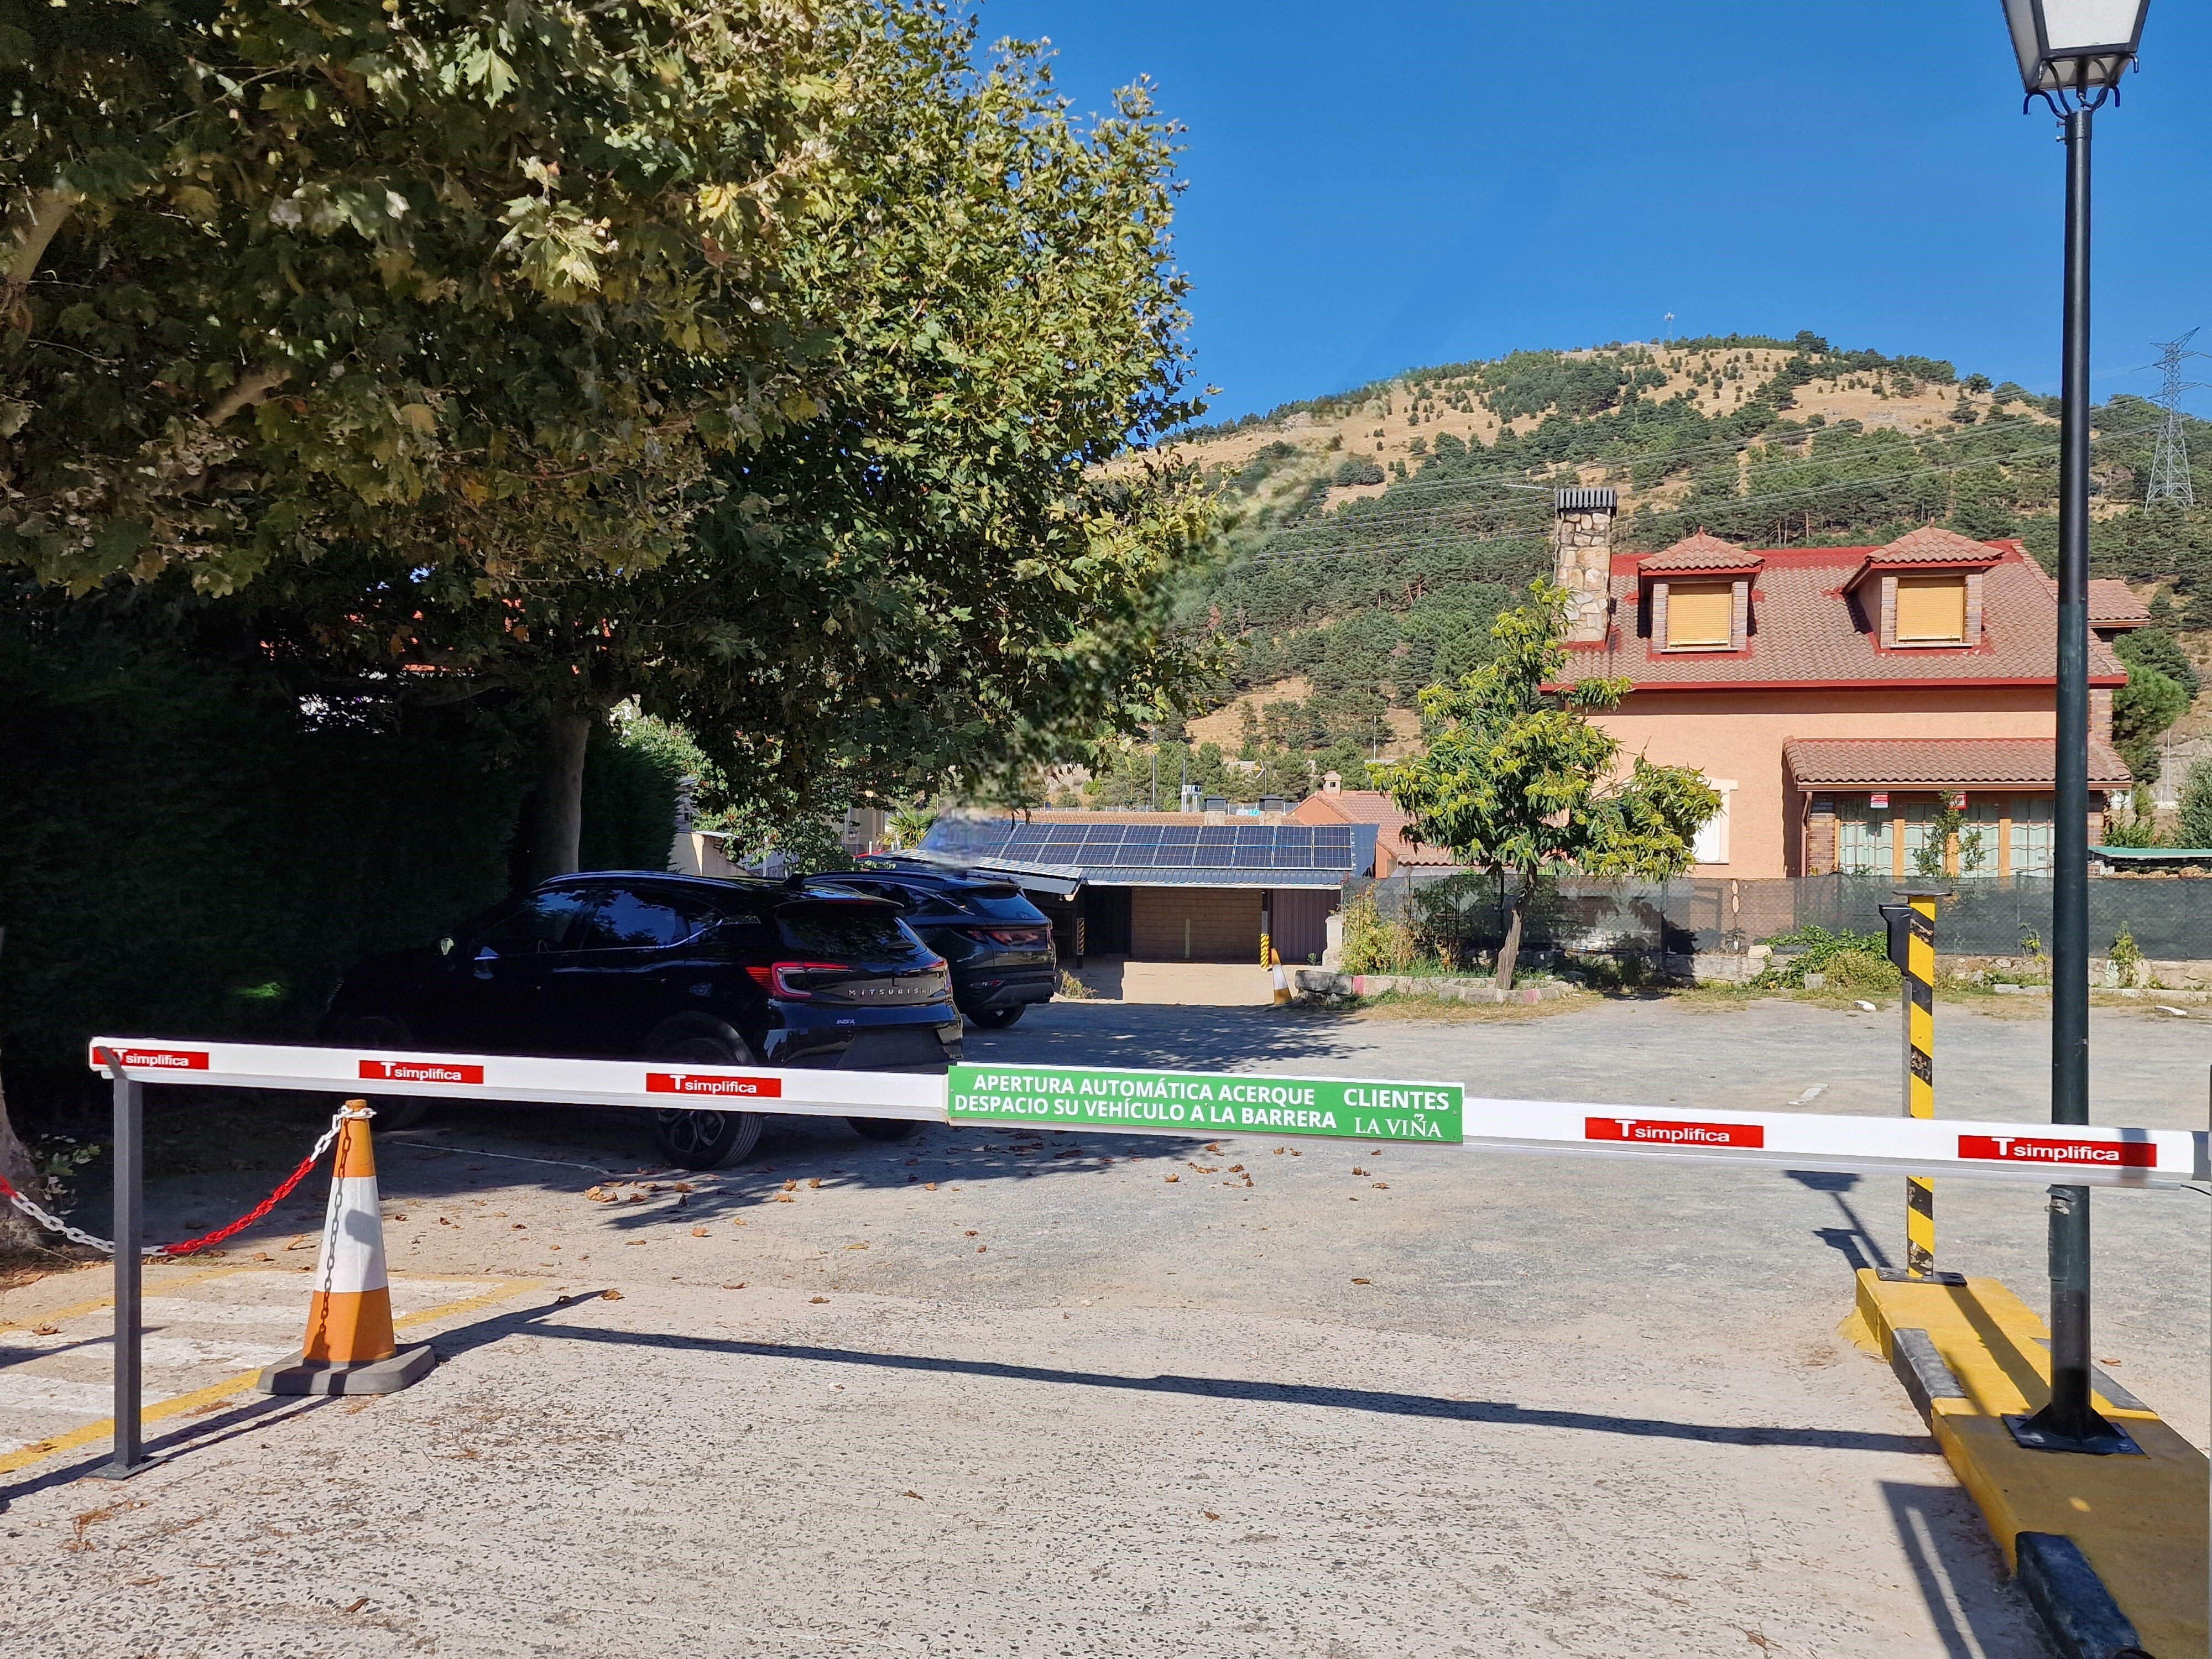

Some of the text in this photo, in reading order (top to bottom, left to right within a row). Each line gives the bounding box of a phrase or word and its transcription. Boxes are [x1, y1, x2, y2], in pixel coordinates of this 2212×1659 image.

[848, 988, 932, 997] MITSUBISHI
[973, 1074, 1315, 1108] APERTURA AUTOMÁTICA ACERQUE
[1344, 1088, 1449, 1110] CLIENTES
[955, 1094, 1337, 1129] DESPACIO SU VEHÍCULO A LA BARRERA
[1354, 1113, 1443, 1138] LA VIÑA
